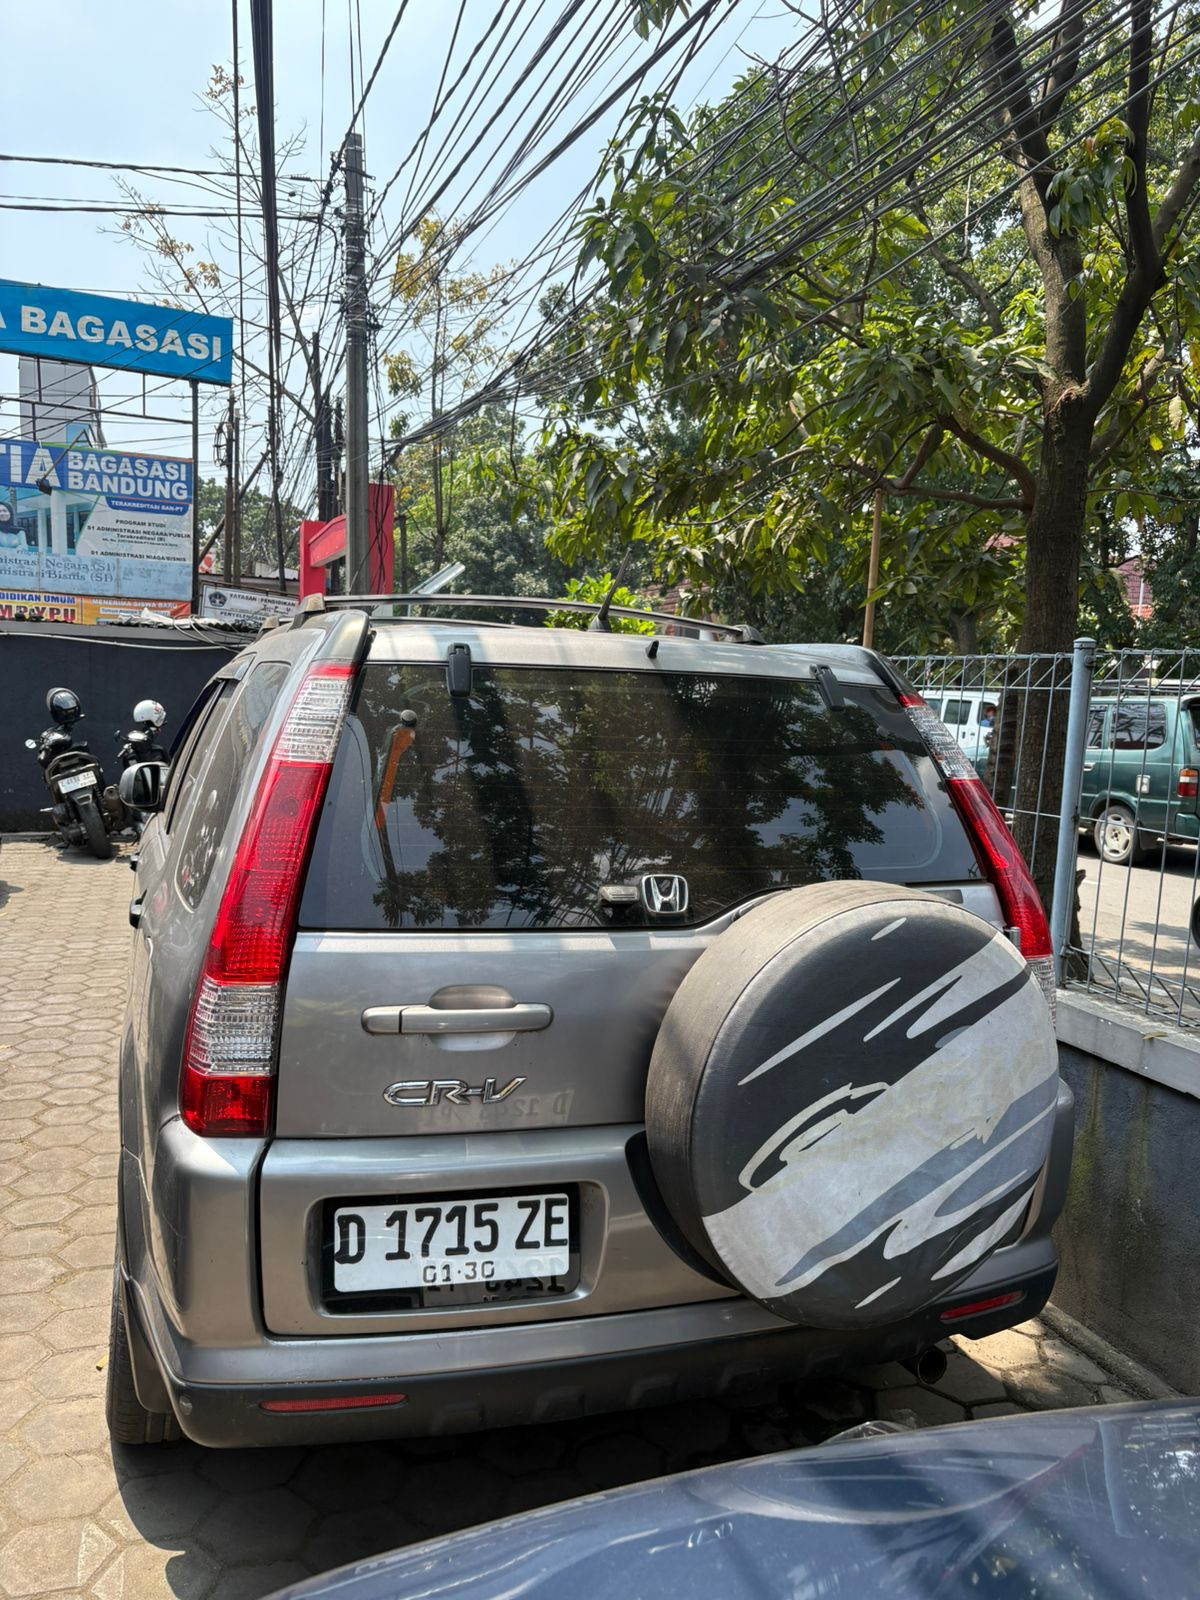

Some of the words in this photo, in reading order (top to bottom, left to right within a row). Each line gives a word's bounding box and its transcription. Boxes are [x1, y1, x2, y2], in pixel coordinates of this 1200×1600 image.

[21, 305, 222, 362] BAGASASI
[0, 443, 61, 487] IA
[67, 451, 187, 482] BAGASASI
[67, 471, 188, 500] BANDUNG
[115, 519, 146, 527] PROGRAM
[44, 594, 76, 604] UMUM
[230, 593, 257, 602] YAYASAN
[383, 1076, 527, 1107] CR-V
[334, 1213, 366, 1264] D
[385, 1202, 499, 1262] 1715
[515, 1197, 568, 1250] ZE
